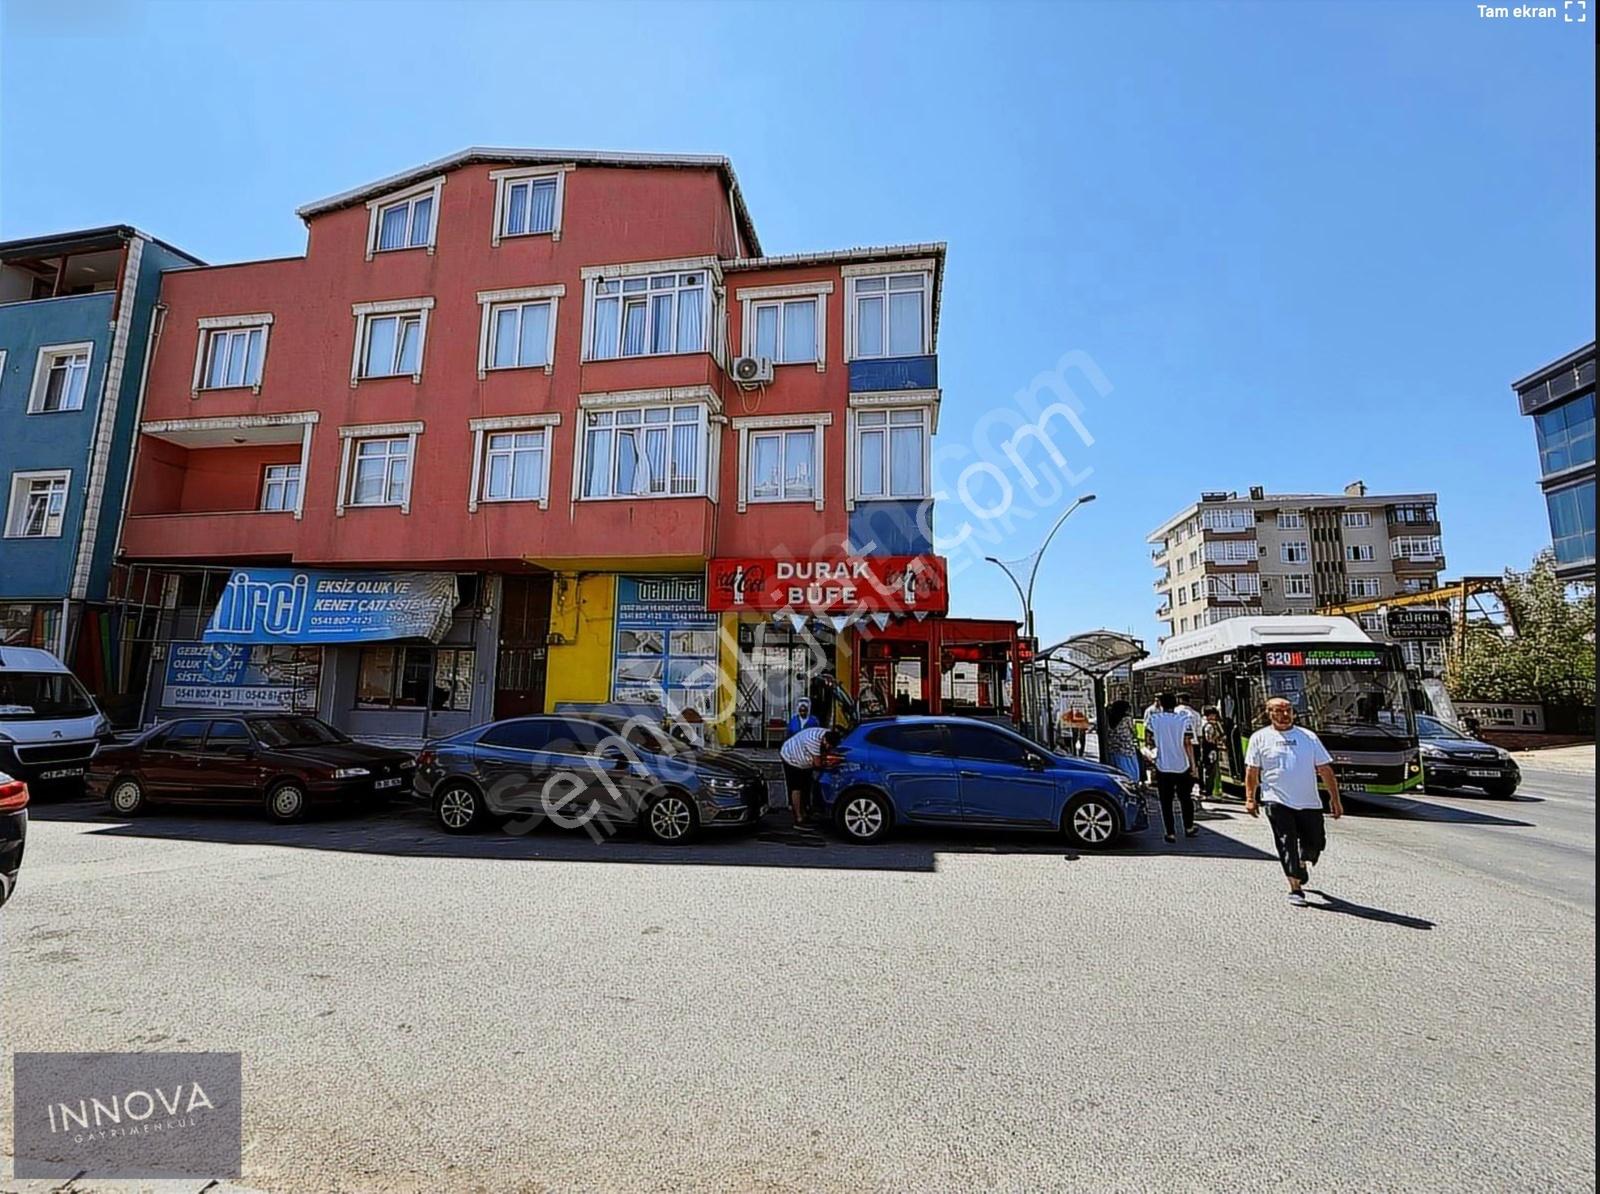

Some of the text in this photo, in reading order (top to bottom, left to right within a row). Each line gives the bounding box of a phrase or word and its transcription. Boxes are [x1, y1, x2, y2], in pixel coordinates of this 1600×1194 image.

[777, 561, 870, 580] DURAK
[316, 578, 411, 594] EKSİZ OLUK VE
[788, 582, 858, 605] BÜFE
[313, 599, 357, 612] KENET
